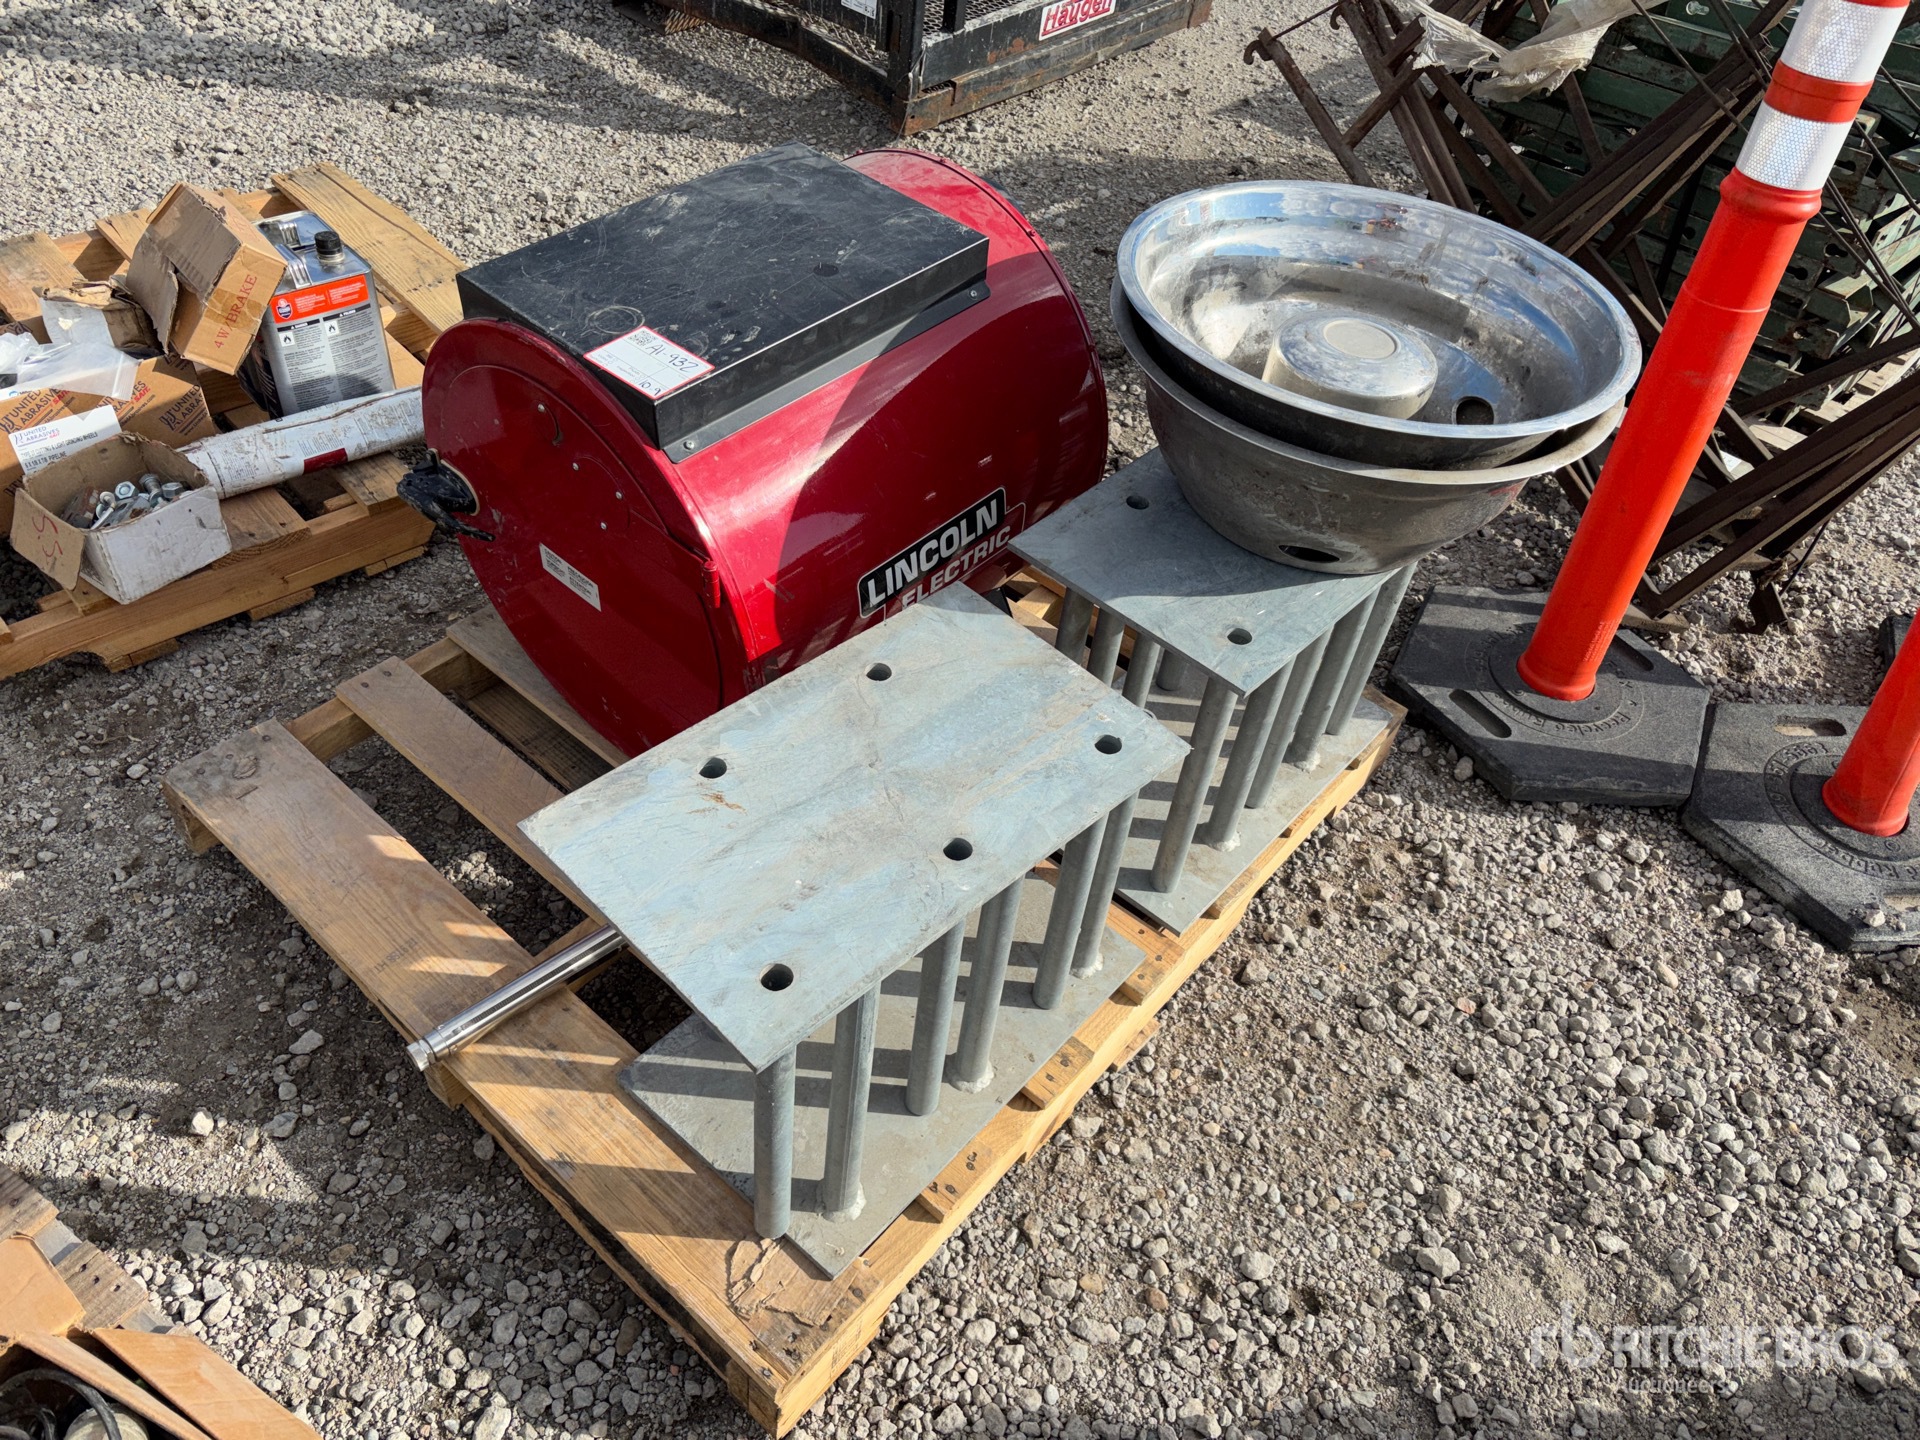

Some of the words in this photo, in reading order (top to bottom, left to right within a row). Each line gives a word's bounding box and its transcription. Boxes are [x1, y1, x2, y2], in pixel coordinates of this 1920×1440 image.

[9, 389, 42, 418] UNITED
[171, 384, 201, 412] UNITED
[23, 426, 47, 437] UNITED
[26, 428, 60, 442] ABRASIVES
[866, 498, 998, 608] LINCOLN
[901, 524, 1012, 609] ELECTRIC
